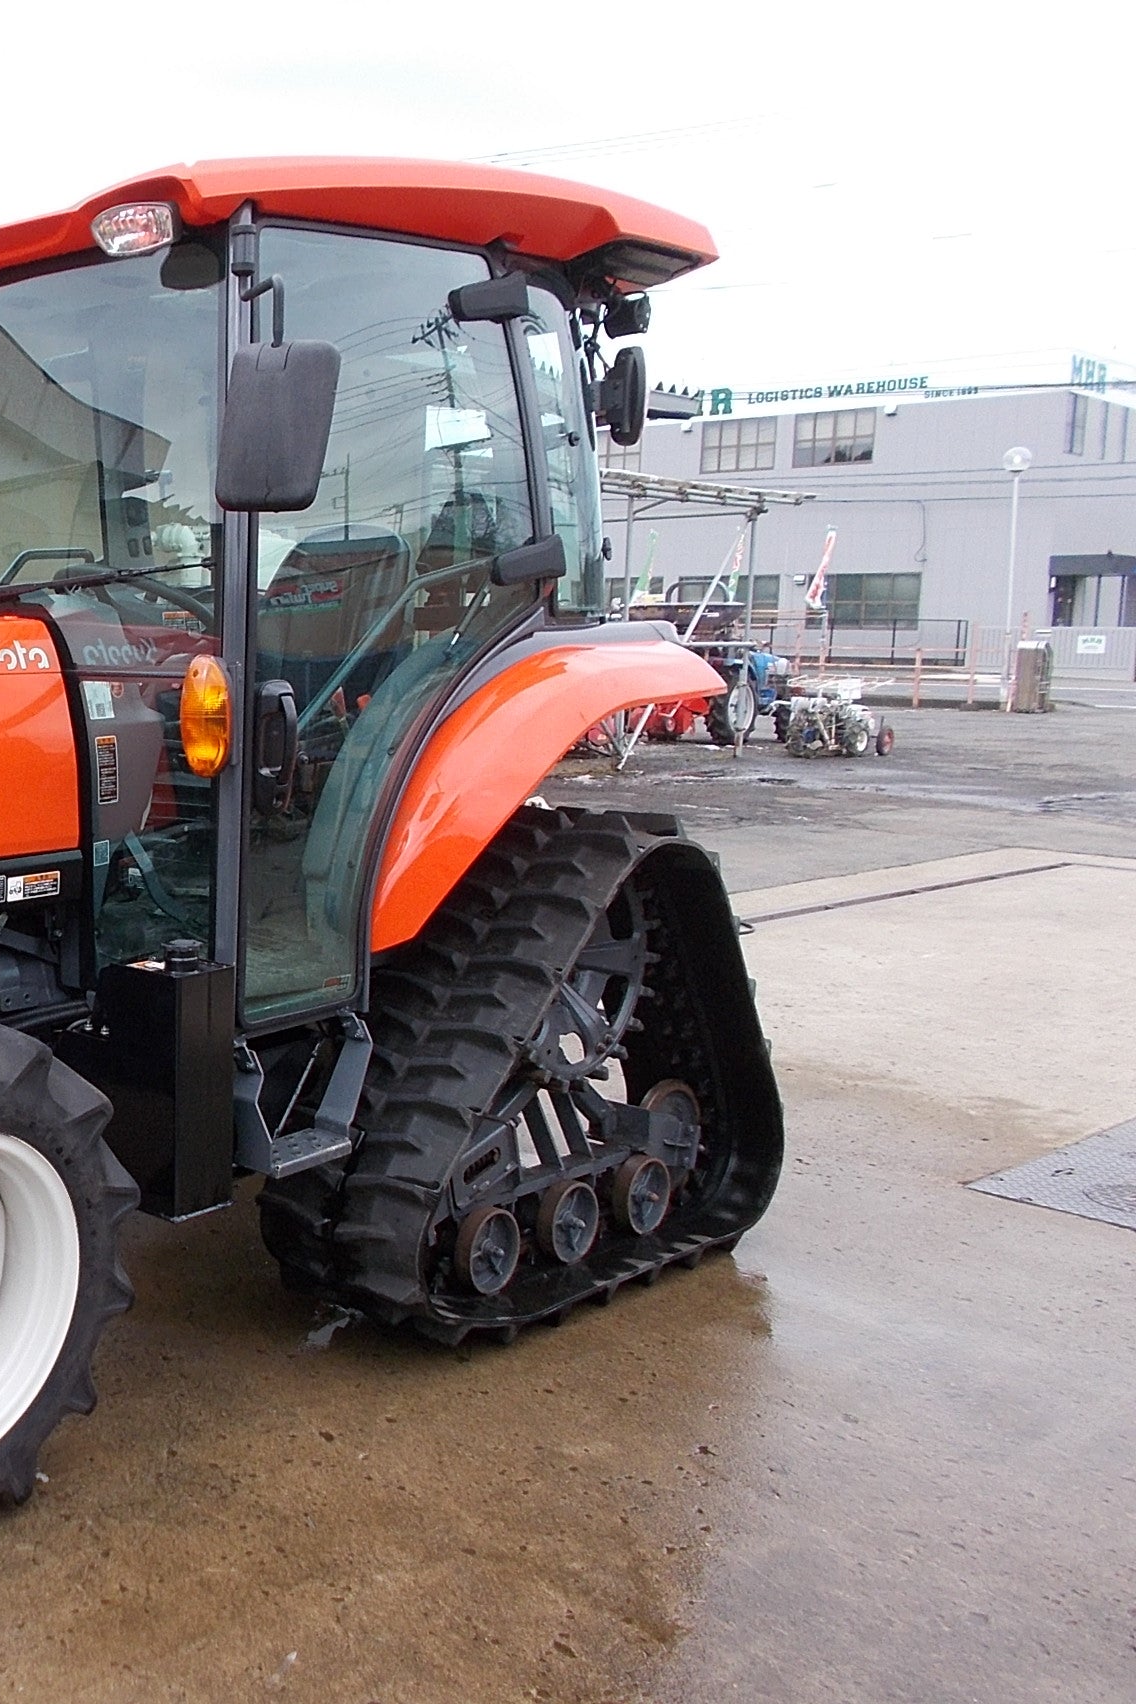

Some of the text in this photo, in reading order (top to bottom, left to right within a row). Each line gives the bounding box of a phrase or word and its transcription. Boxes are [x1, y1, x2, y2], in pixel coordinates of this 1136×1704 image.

[748, 386, 823, 404] LOGISTICS
[827, 376, 929, 398] WAREHOUSE
[924, 389, 955, 399] SINCE
